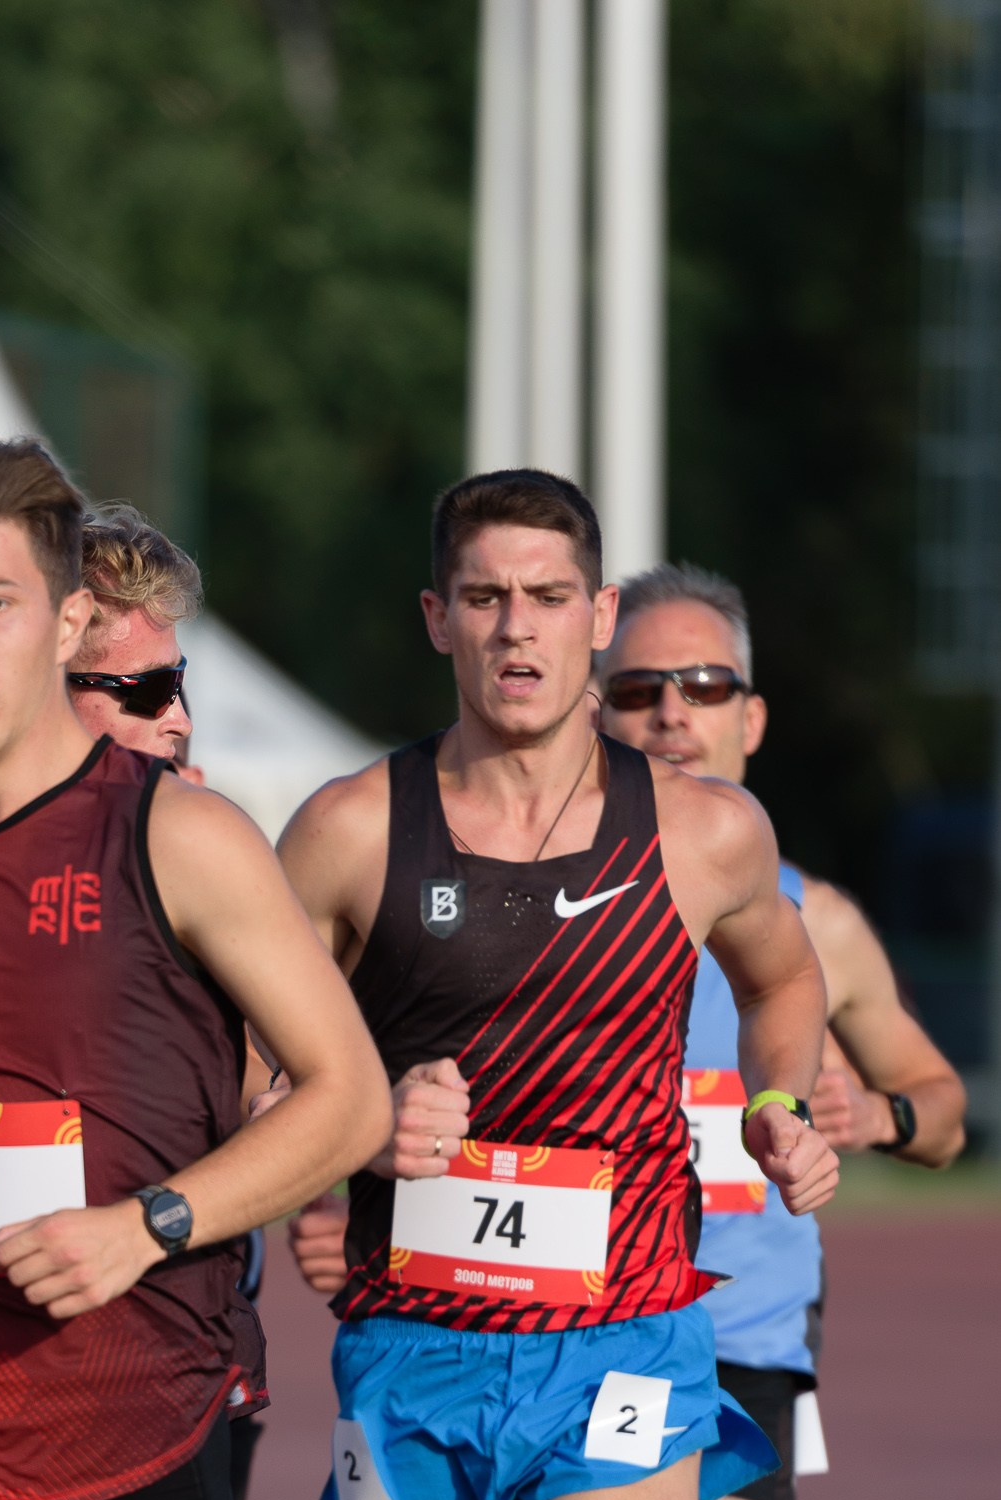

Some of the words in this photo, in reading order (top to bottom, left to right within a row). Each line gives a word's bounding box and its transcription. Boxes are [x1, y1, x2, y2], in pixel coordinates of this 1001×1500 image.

[472, 1195, 526, 1248] 74
[454, 1268, 485, 1286] 3000
[487, 1274, 534, 1292] метров
[615, 1404, 638, 1435] 2
[344, 1449, 361, 1481] 2
